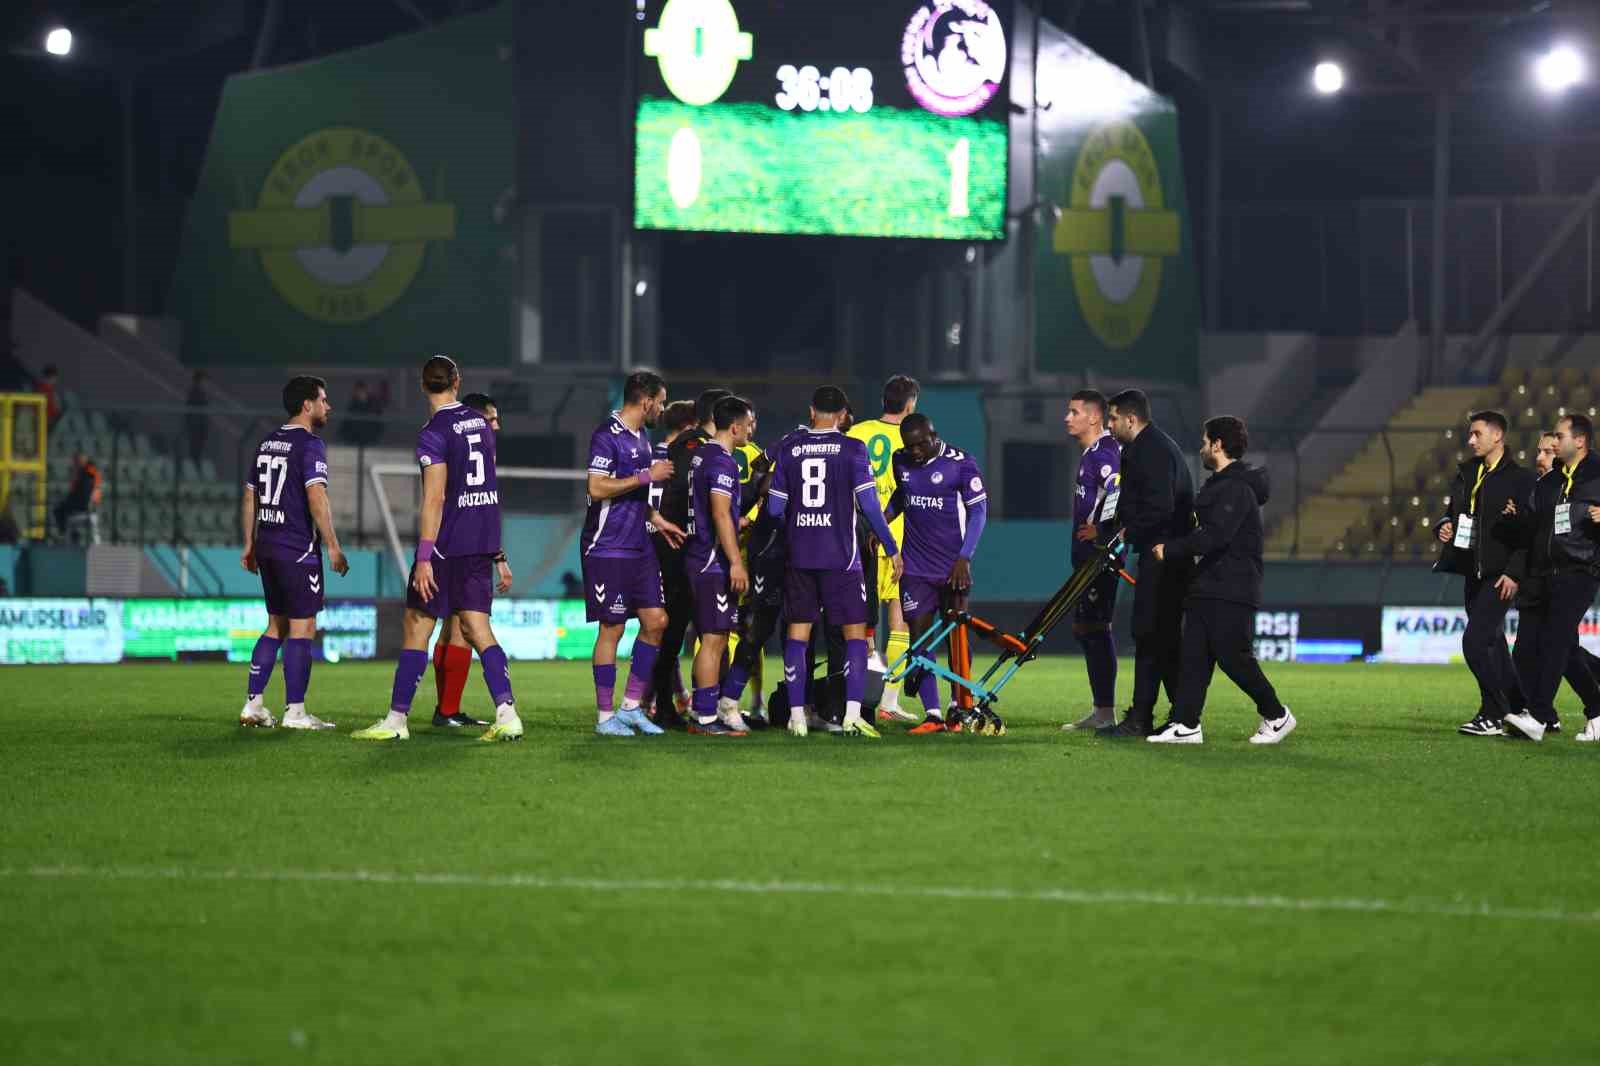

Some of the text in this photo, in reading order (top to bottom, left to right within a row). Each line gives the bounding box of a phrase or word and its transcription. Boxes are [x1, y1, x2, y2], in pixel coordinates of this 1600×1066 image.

[775, 64, 873, 113] 36:08
[668, 127, 702, 209] 0
[948, 137, 970, 218] 1
[257, 454, 288, 505] 37
[466, 434, 485, 486] 5
[868, 433, 892, 477] 9
[801, 458, 826, 507] 8
[911, 495, 943, 510] KEÇTAŞ
